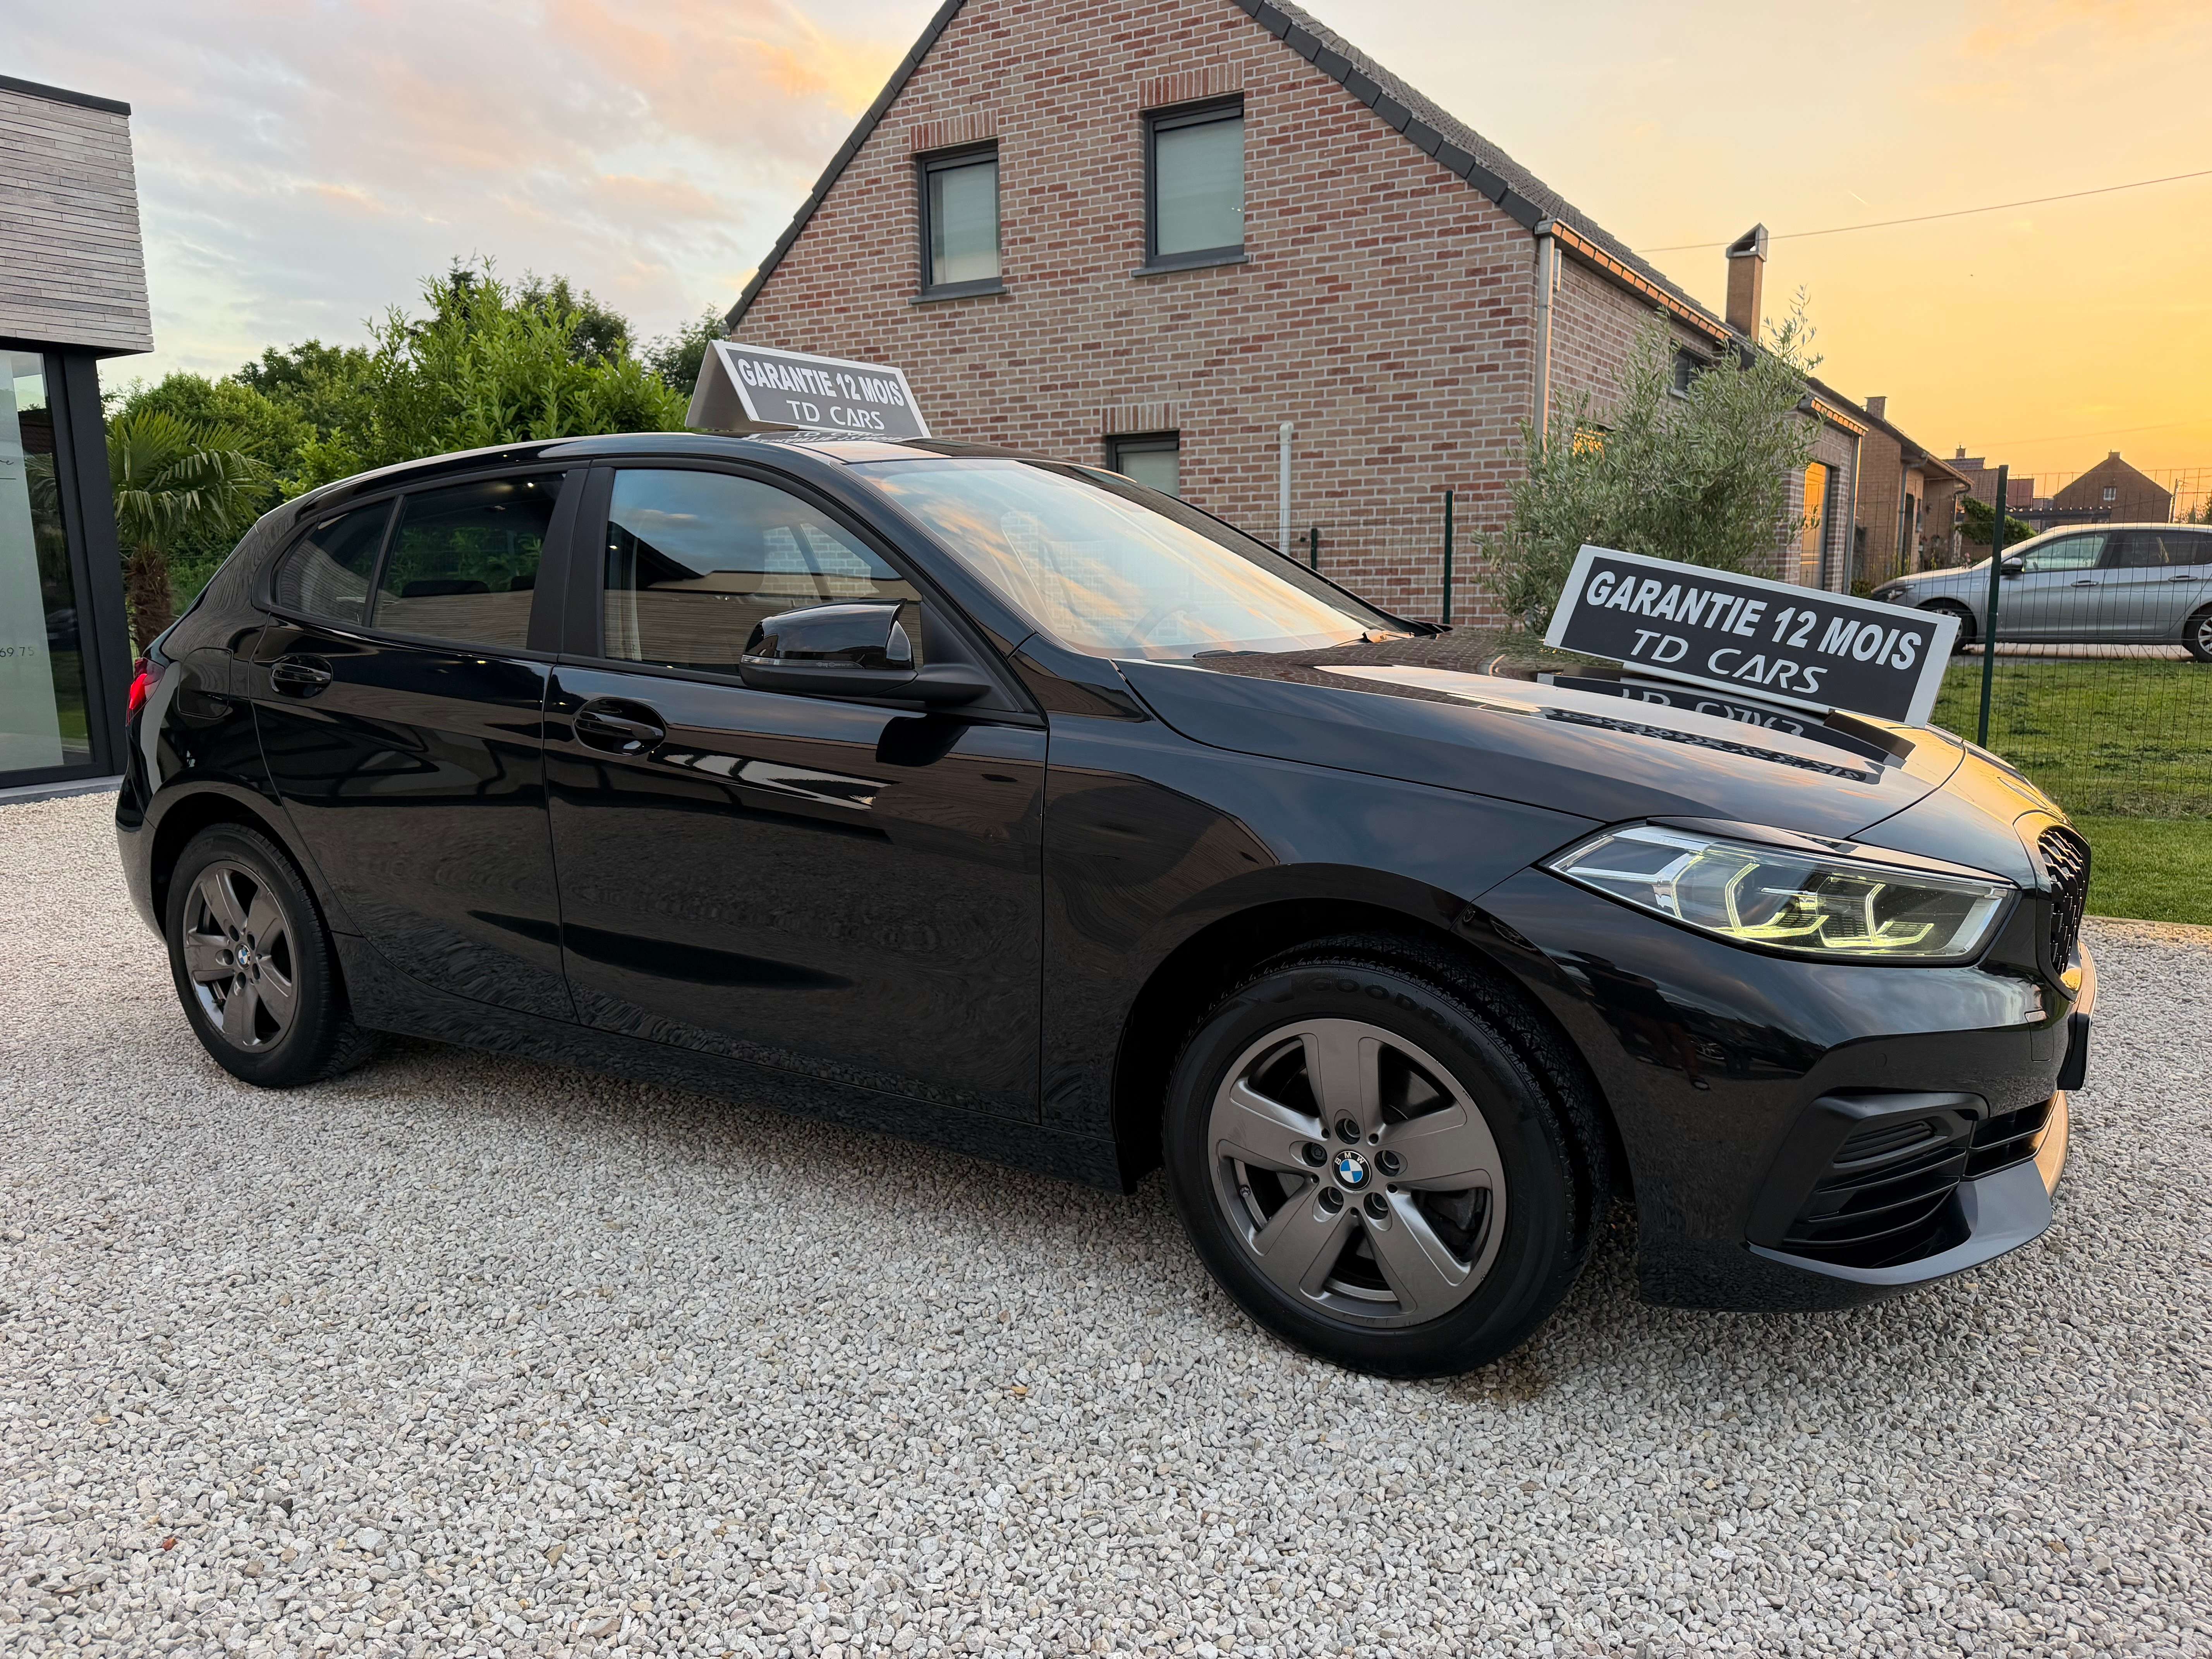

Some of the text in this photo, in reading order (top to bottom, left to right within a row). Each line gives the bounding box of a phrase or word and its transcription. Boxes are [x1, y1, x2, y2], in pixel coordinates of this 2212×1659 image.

[738, 359, 904, 406] GARANTIE 12 MOIS
[786, 400, 885, 430] TD CARS
[1587, 571, 1922, 670] GARANTIE 12 MOIS
[1630, 629, 1828, 694] TD CARS
[1334, 1152, 1365, 1165] BMW
